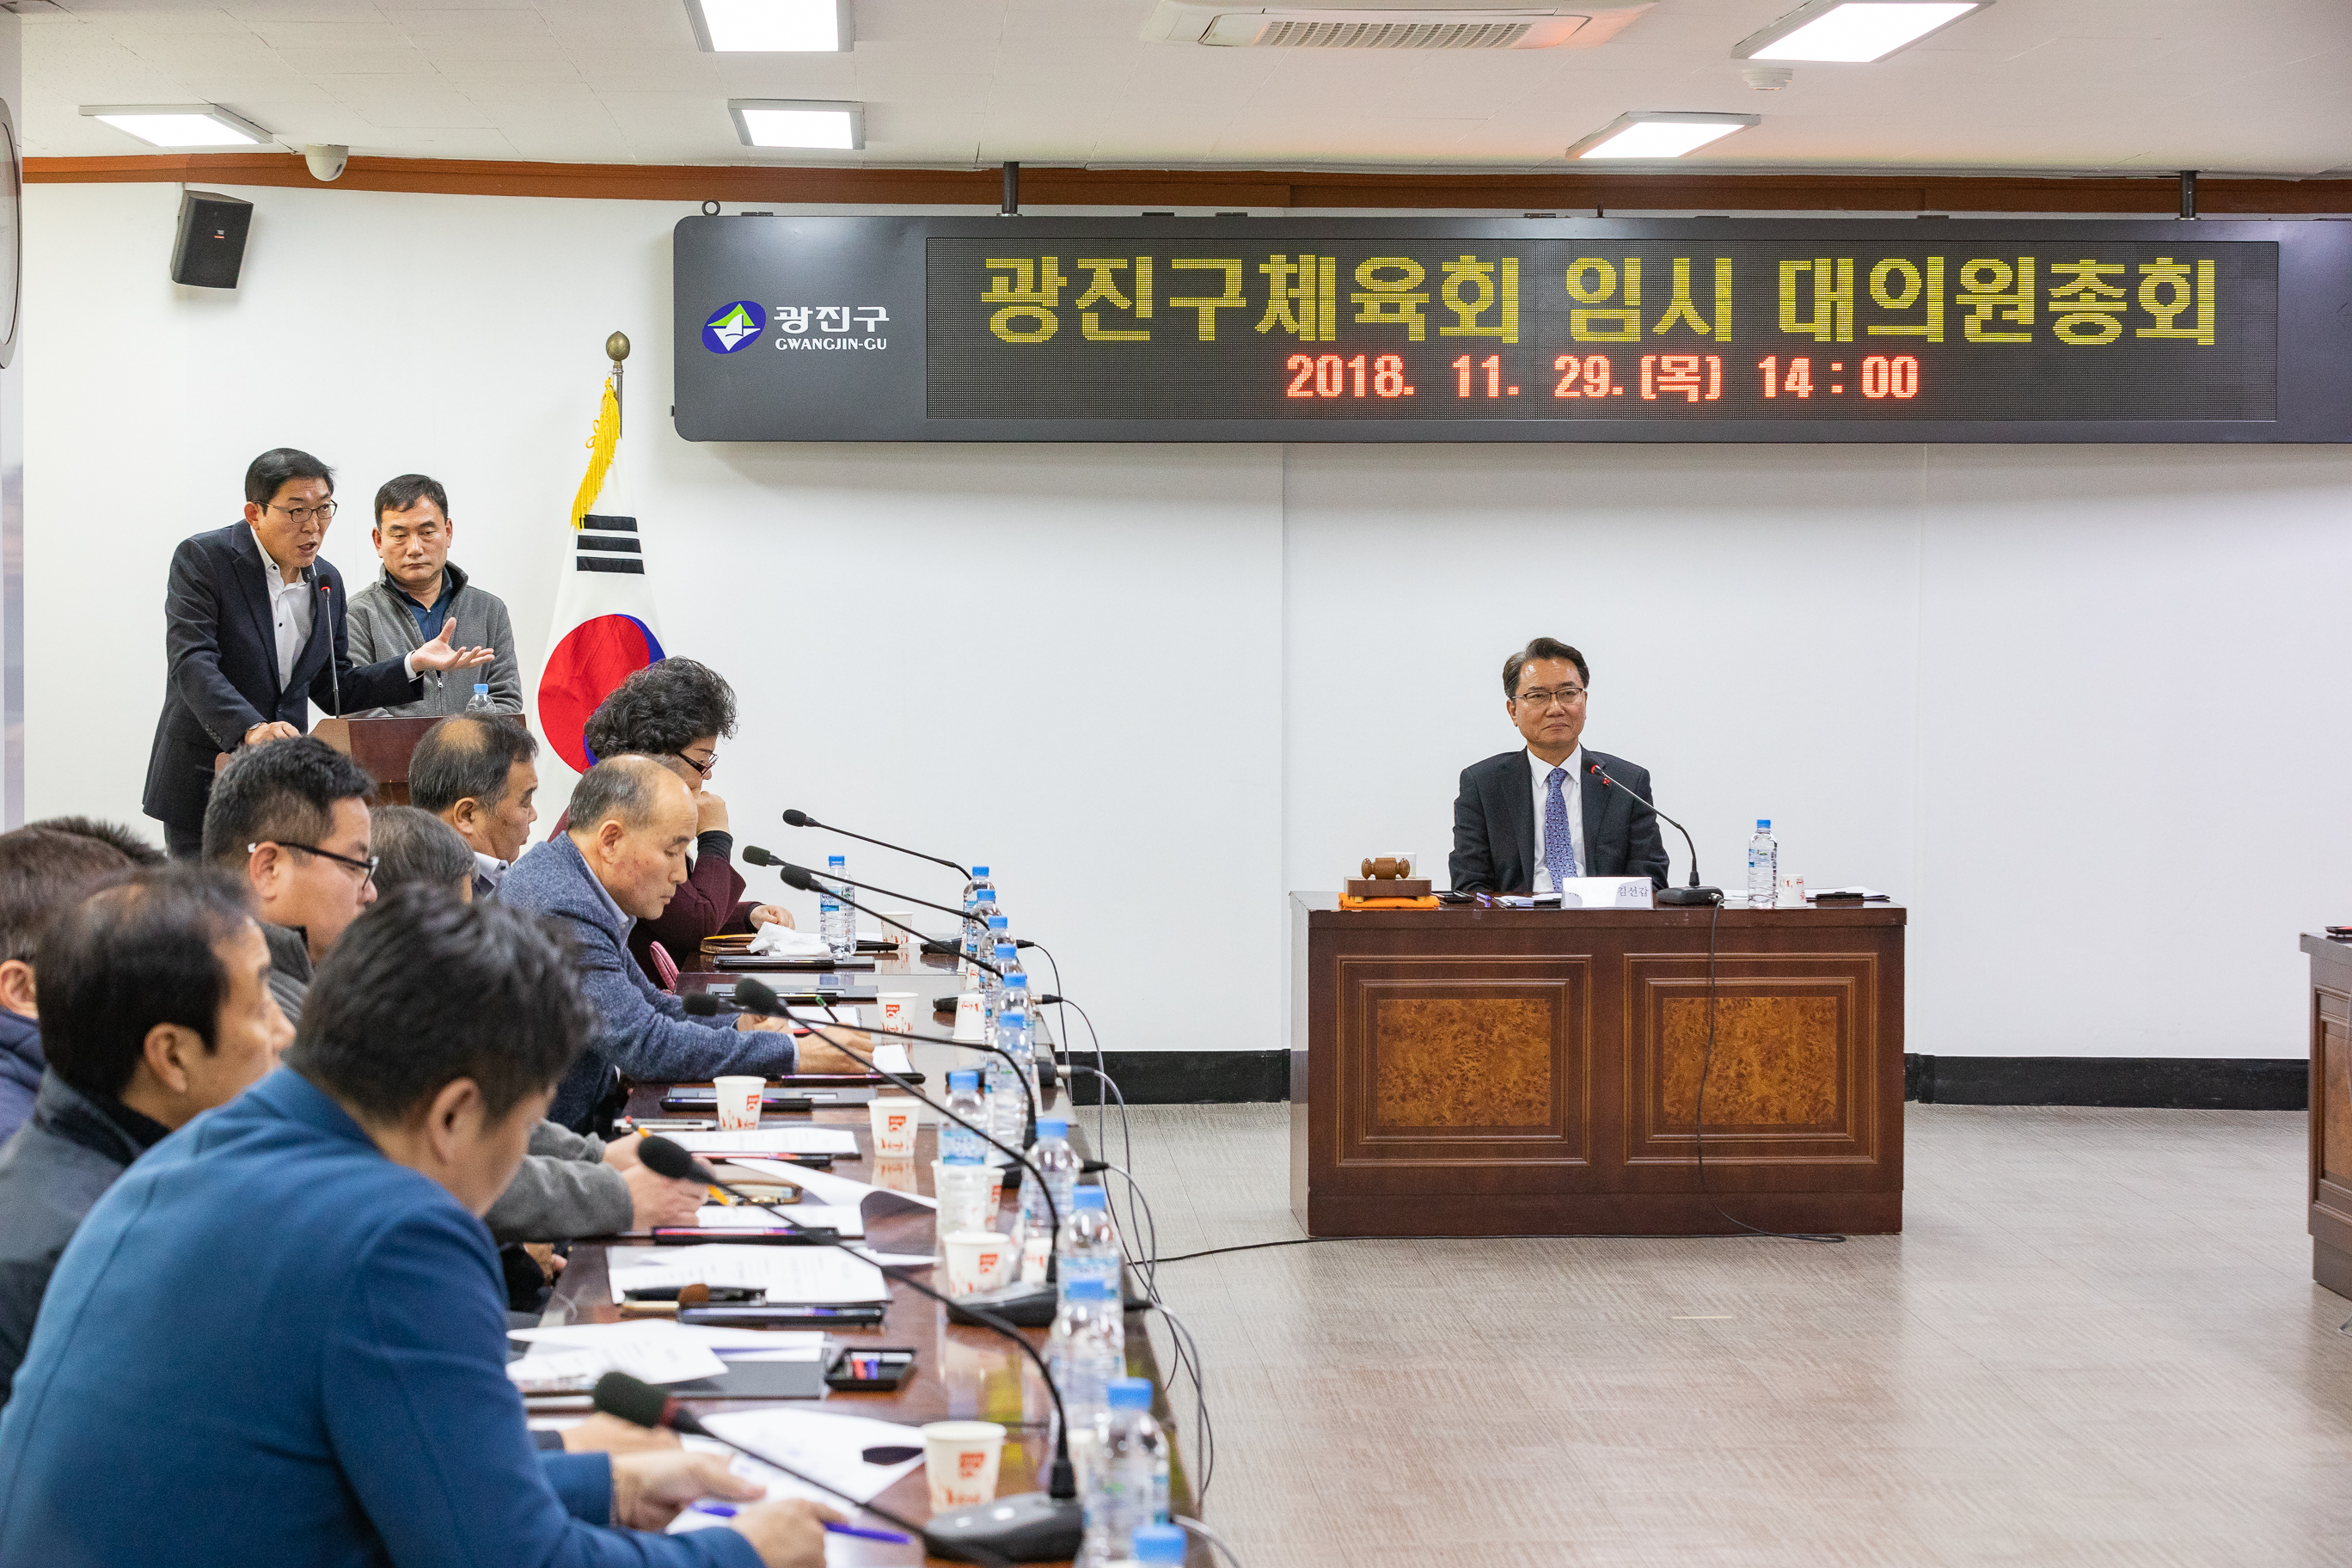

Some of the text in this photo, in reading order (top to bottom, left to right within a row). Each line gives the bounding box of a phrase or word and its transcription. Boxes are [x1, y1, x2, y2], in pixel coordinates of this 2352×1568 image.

[981, 254, 2215, 346] 광진구체육회 임시 대의원총회
[774, 307, 890, 334] 광진구
[775, 338, 887, 351] GWANGJIN-GU
[1286, 354, 1415, 398] 2018.
[1452, 354, 1520, 398] 11.
[1617, 885, 1650, 897] 김선갑
